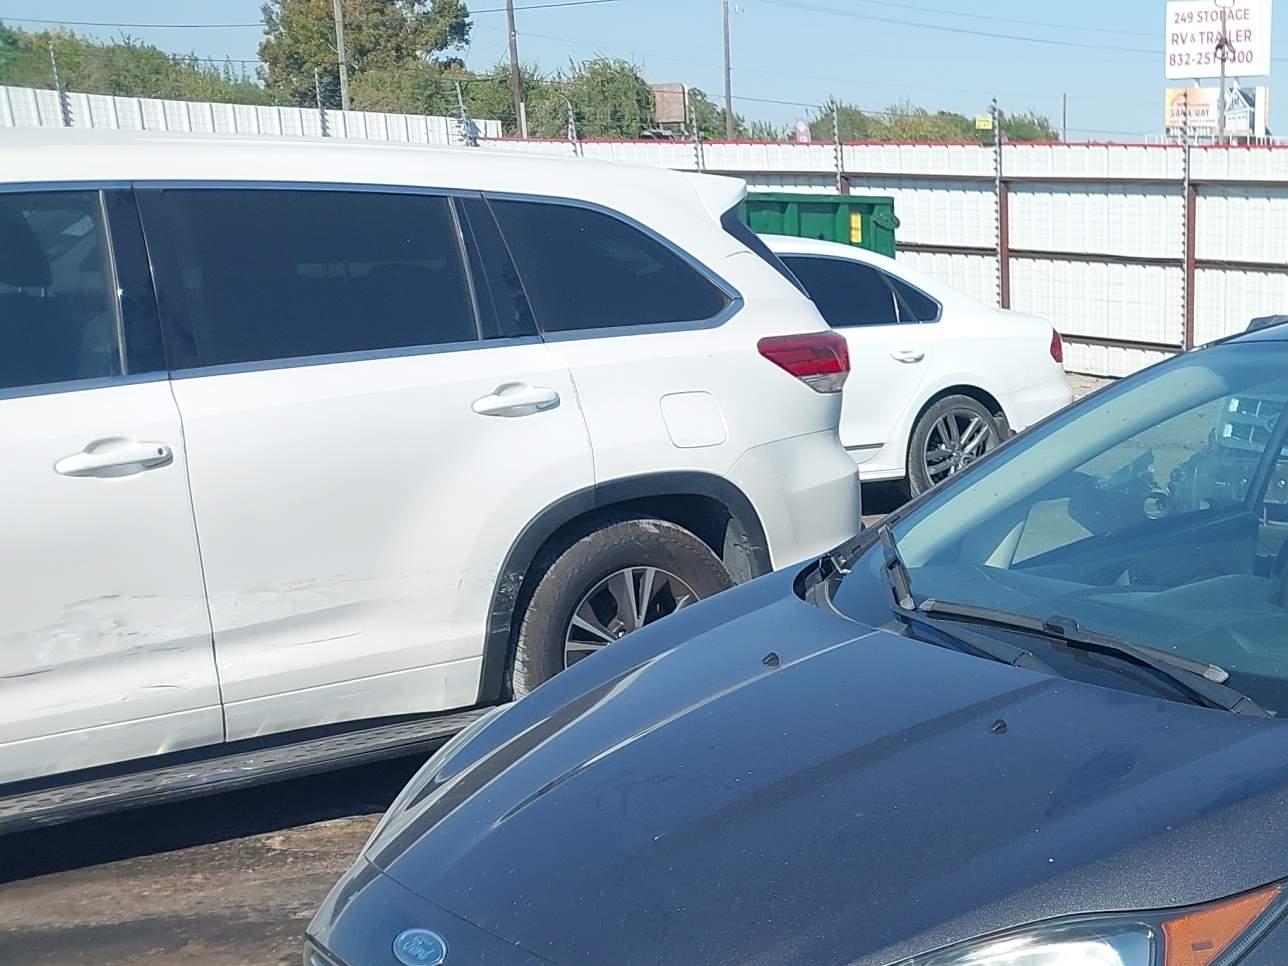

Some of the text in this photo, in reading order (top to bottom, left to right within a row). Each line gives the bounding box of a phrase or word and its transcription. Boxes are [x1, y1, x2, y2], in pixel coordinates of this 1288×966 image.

[1174, 11, 1194, 24] 249
[1171, 31, 1188, 46] RV
[1199, 29, 1252, 45] TRALER
[1169, 50, 1253, 66] 832-25100
